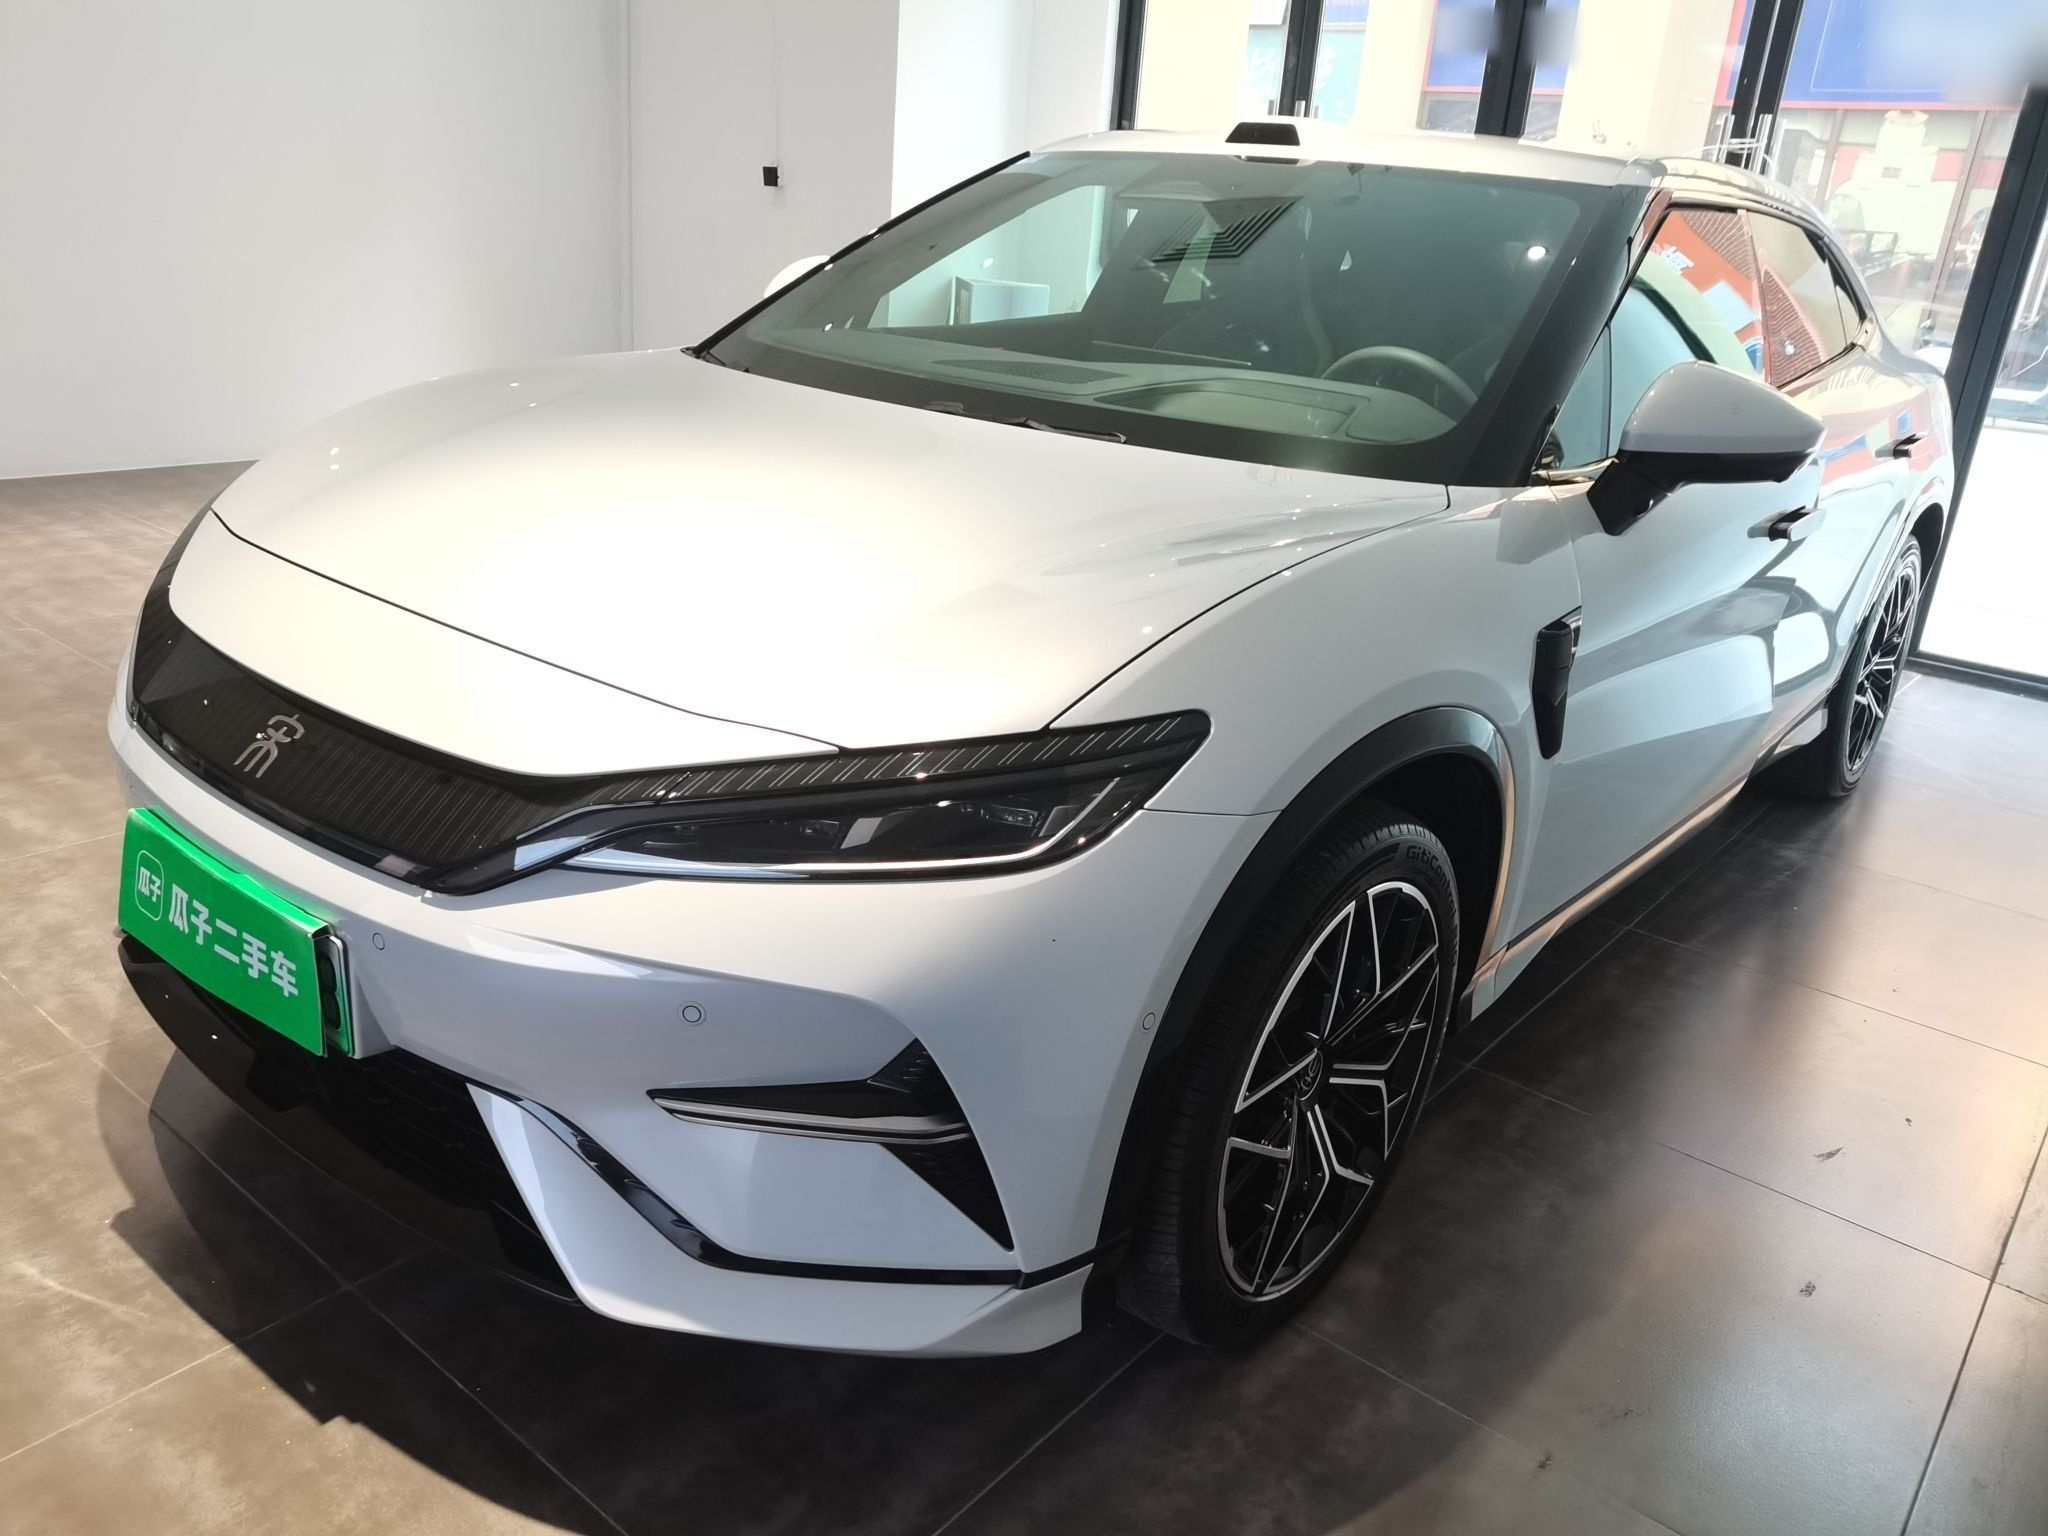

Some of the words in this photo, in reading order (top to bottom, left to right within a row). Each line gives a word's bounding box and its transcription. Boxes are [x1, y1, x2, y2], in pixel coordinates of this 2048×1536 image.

[138, 866, 162, 903] 瓜子
[168, 883, 299, 997] 瓜子二手车
